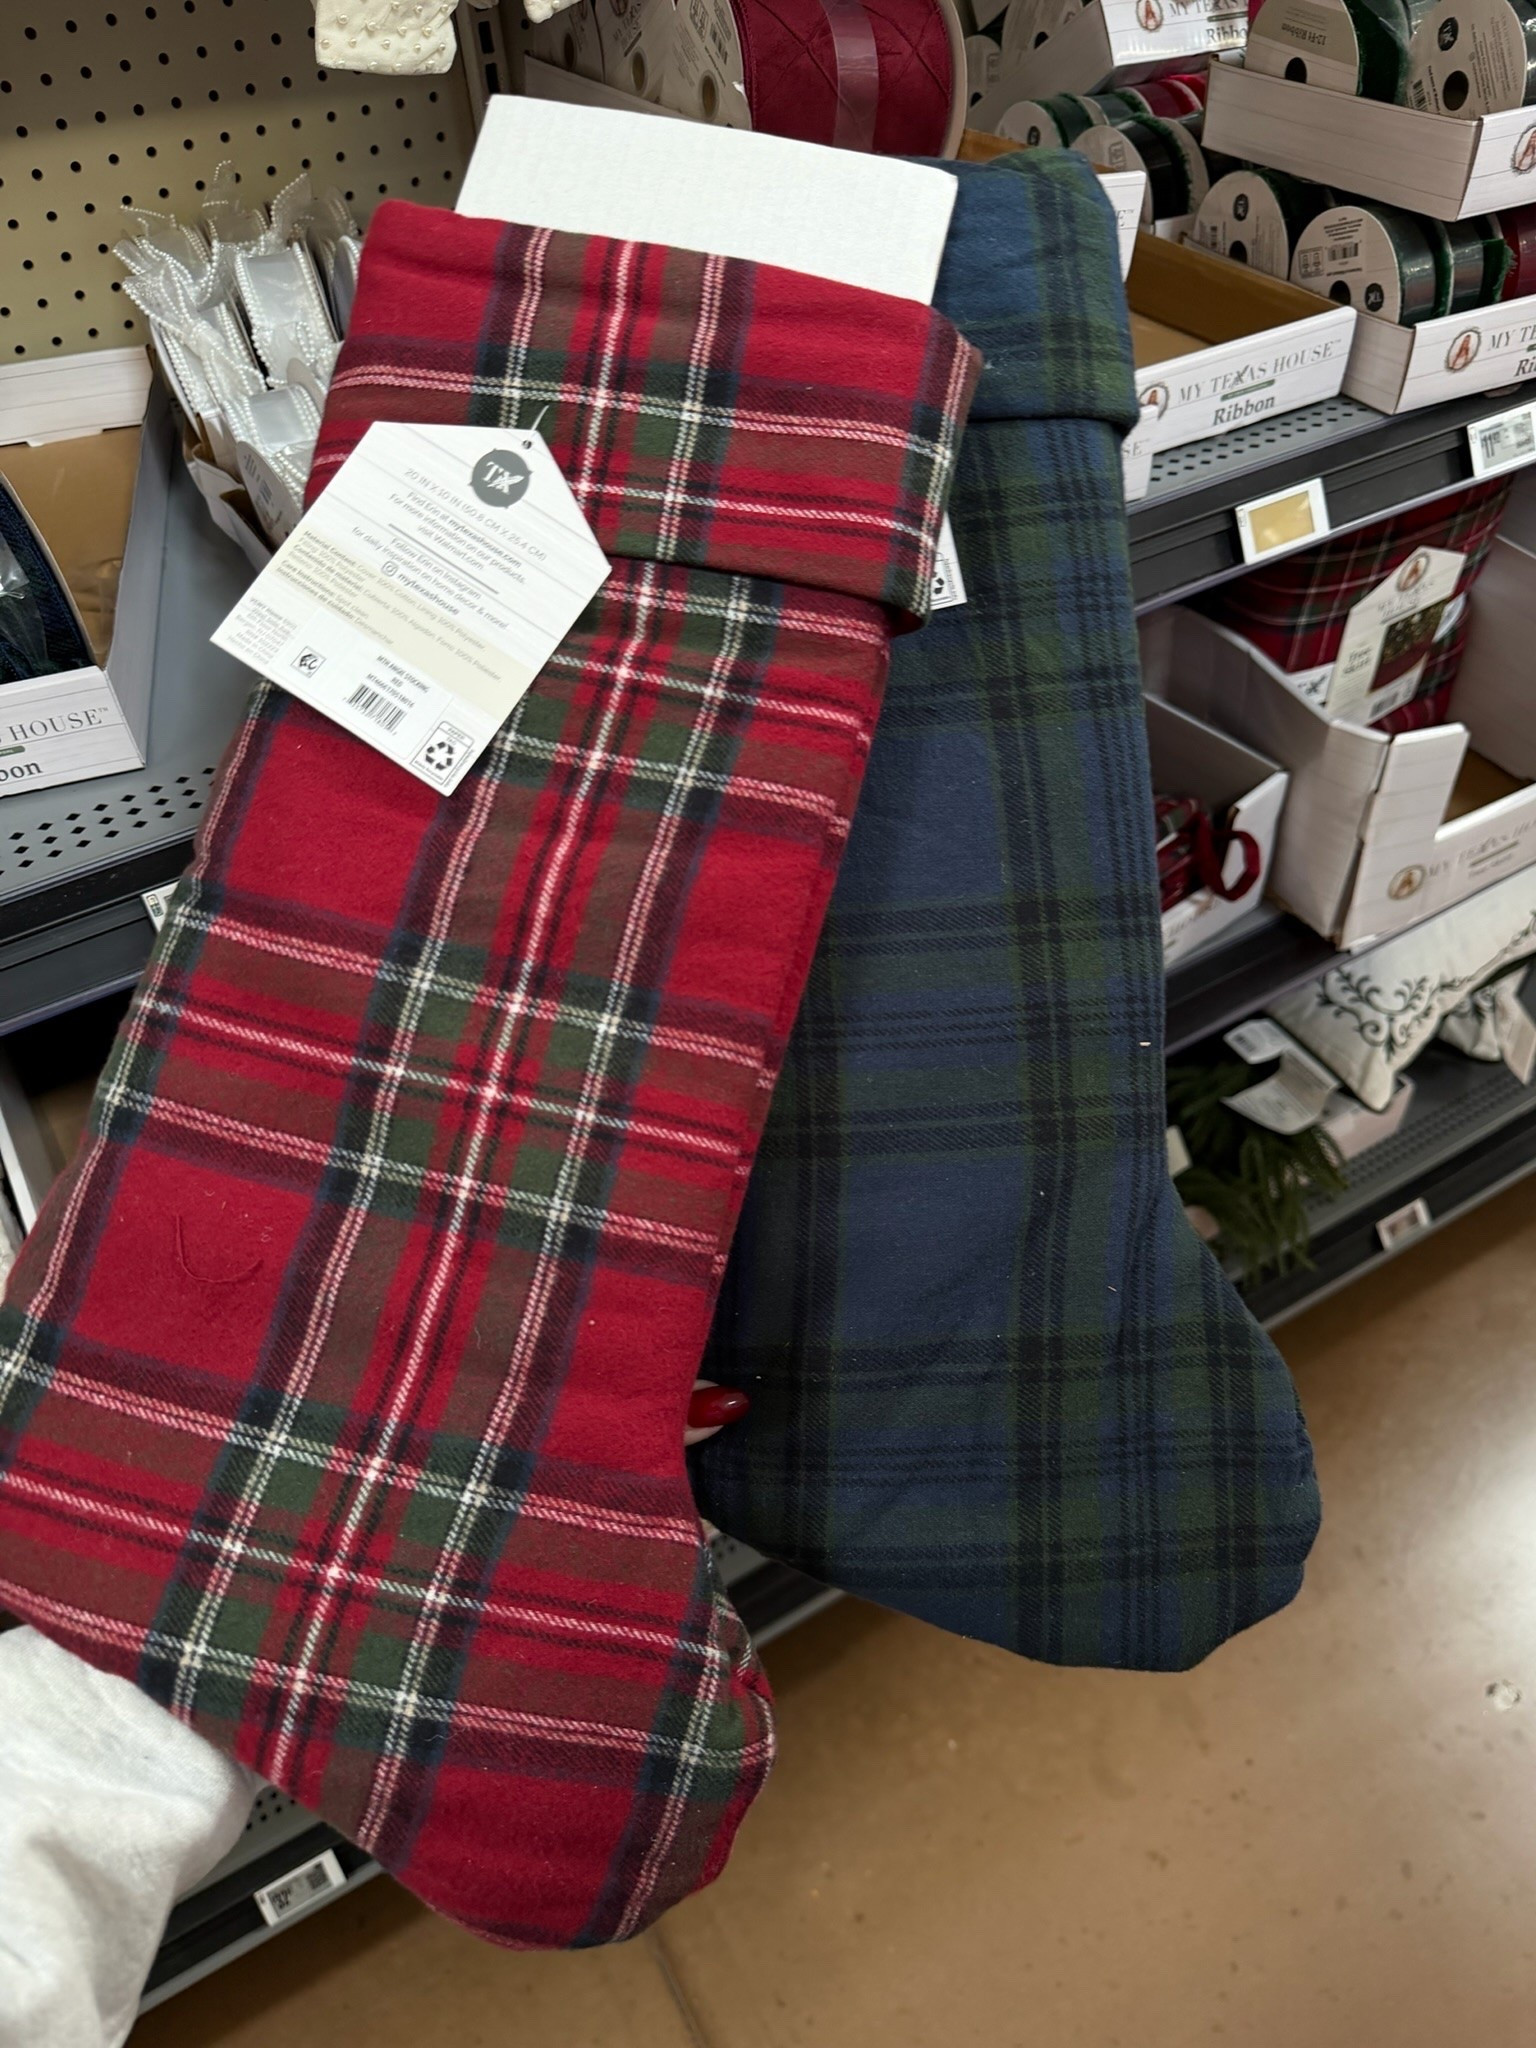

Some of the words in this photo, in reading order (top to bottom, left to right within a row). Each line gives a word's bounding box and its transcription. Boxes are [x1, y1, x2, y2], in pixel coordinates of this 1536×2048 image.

[1170, 1, 1193, 17] MY
[1206, 25, 1247, 45] Ribbo
[1488, 330, 1514, 350] MY
[1180, 381, 1207, 402] MY
[1210, 365, 1273, 393] TEXAS
[1213, 396, 1275, 426] Ribbon
[404, 467, 419, 480] 20
[418, 476, 430, 487] IN
[428, 483, 438, 492] X
[437, 488, 450, 500] 10
[449, 496, 462, 507] IN
[484, 518, 501, 532] CM
[499, 527, 509, 537] X
[406, 491, 426, 506] Find
[423, 502, 440, 516] Erin
[439, 513, 450, 522] at
[388, 493, 404, 505] For
[402, 503, 424, 518] more
[423, 516, 466, 545] information
[465, 543, 477, 553] on
[476, 550, 491, 560] our
[417, 525, 434, 538] visit
[303, 530, 330, 550] Material
[281, 559, 297, 572] Care
[325, 565, 335, 573] de
[351, 526, 365, 536] for
[363, 535, 383, 550] daily
[381, 546, 421, 574] inspiration
[420, 571, 432, 582] on
[431, 577, 454, 595] home
[476, 606, 484, 615] &
[390, 537, 417, 558] Follow
[416, 554, 433, 568] Erin
[431, 566, 444, 576] on
[442, 571, 481, 599] Instagram
[317, 594, 328, 602] de
[397, 573, 459, 614] mytexashouse
[390, 676, 403, 687] RED
